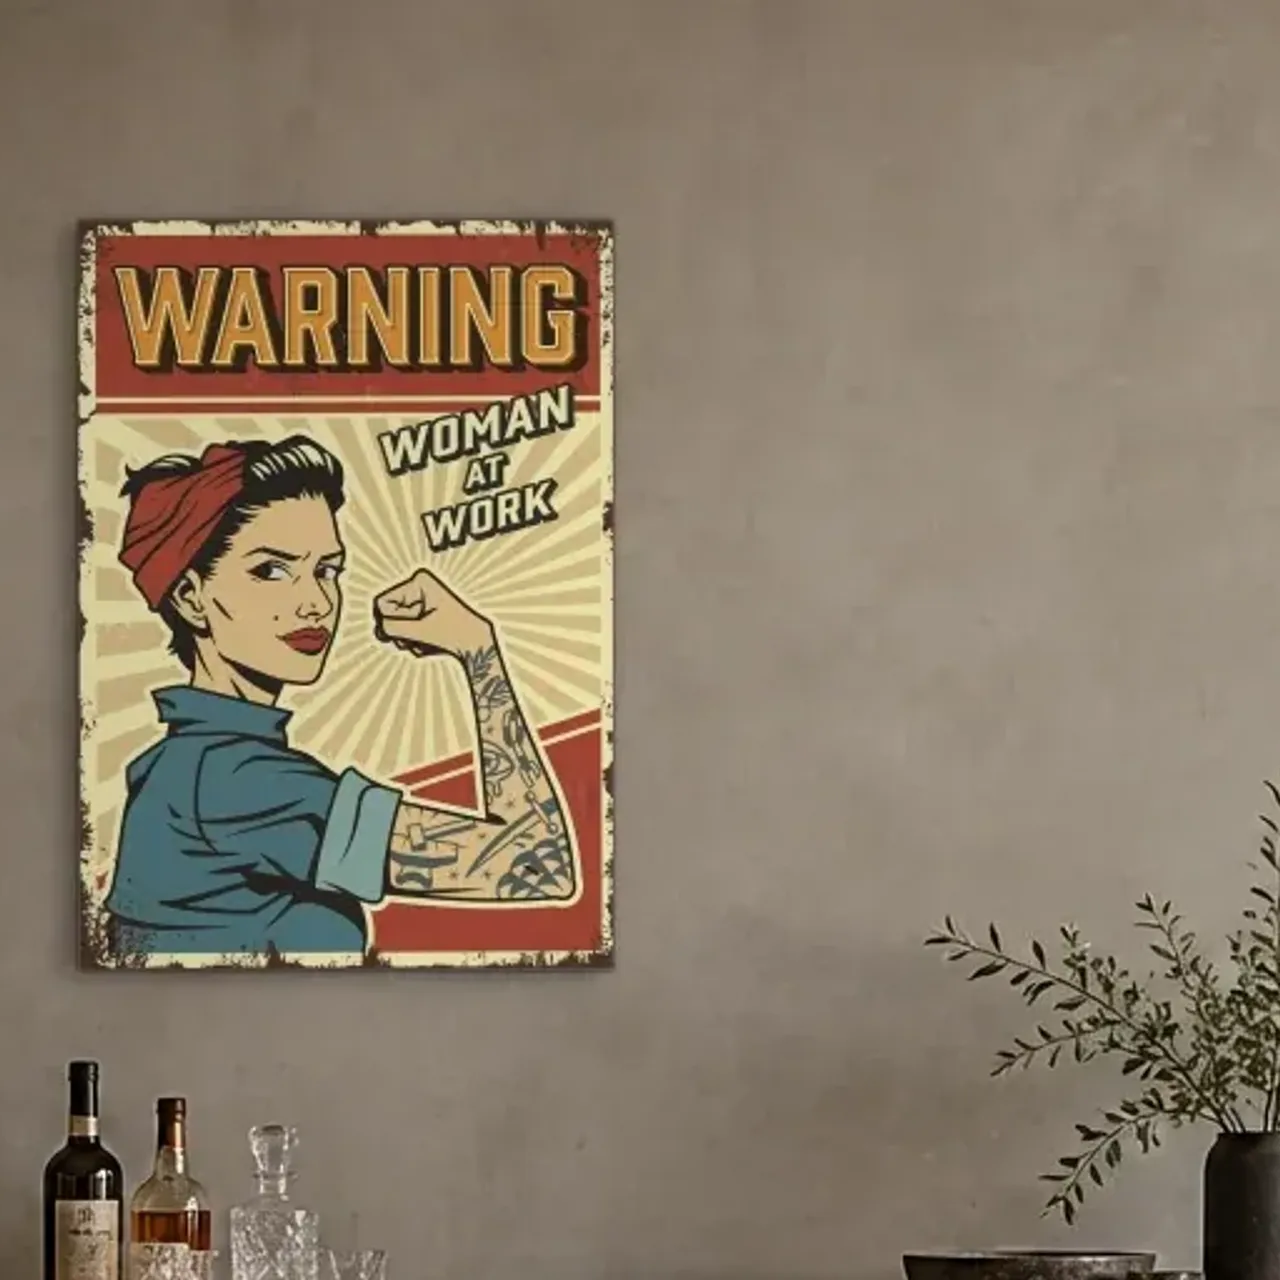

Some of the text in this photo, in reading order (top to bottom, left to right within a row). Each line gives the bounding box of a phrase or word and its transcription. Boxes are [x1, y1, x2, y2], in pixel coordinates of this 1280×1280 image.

[114, 265, 589, 372] WARNING
[379, 385, 575, 475] WOMAN
[462, 453, 507, 491] AT
[422, 481, 558, 551] WORK
